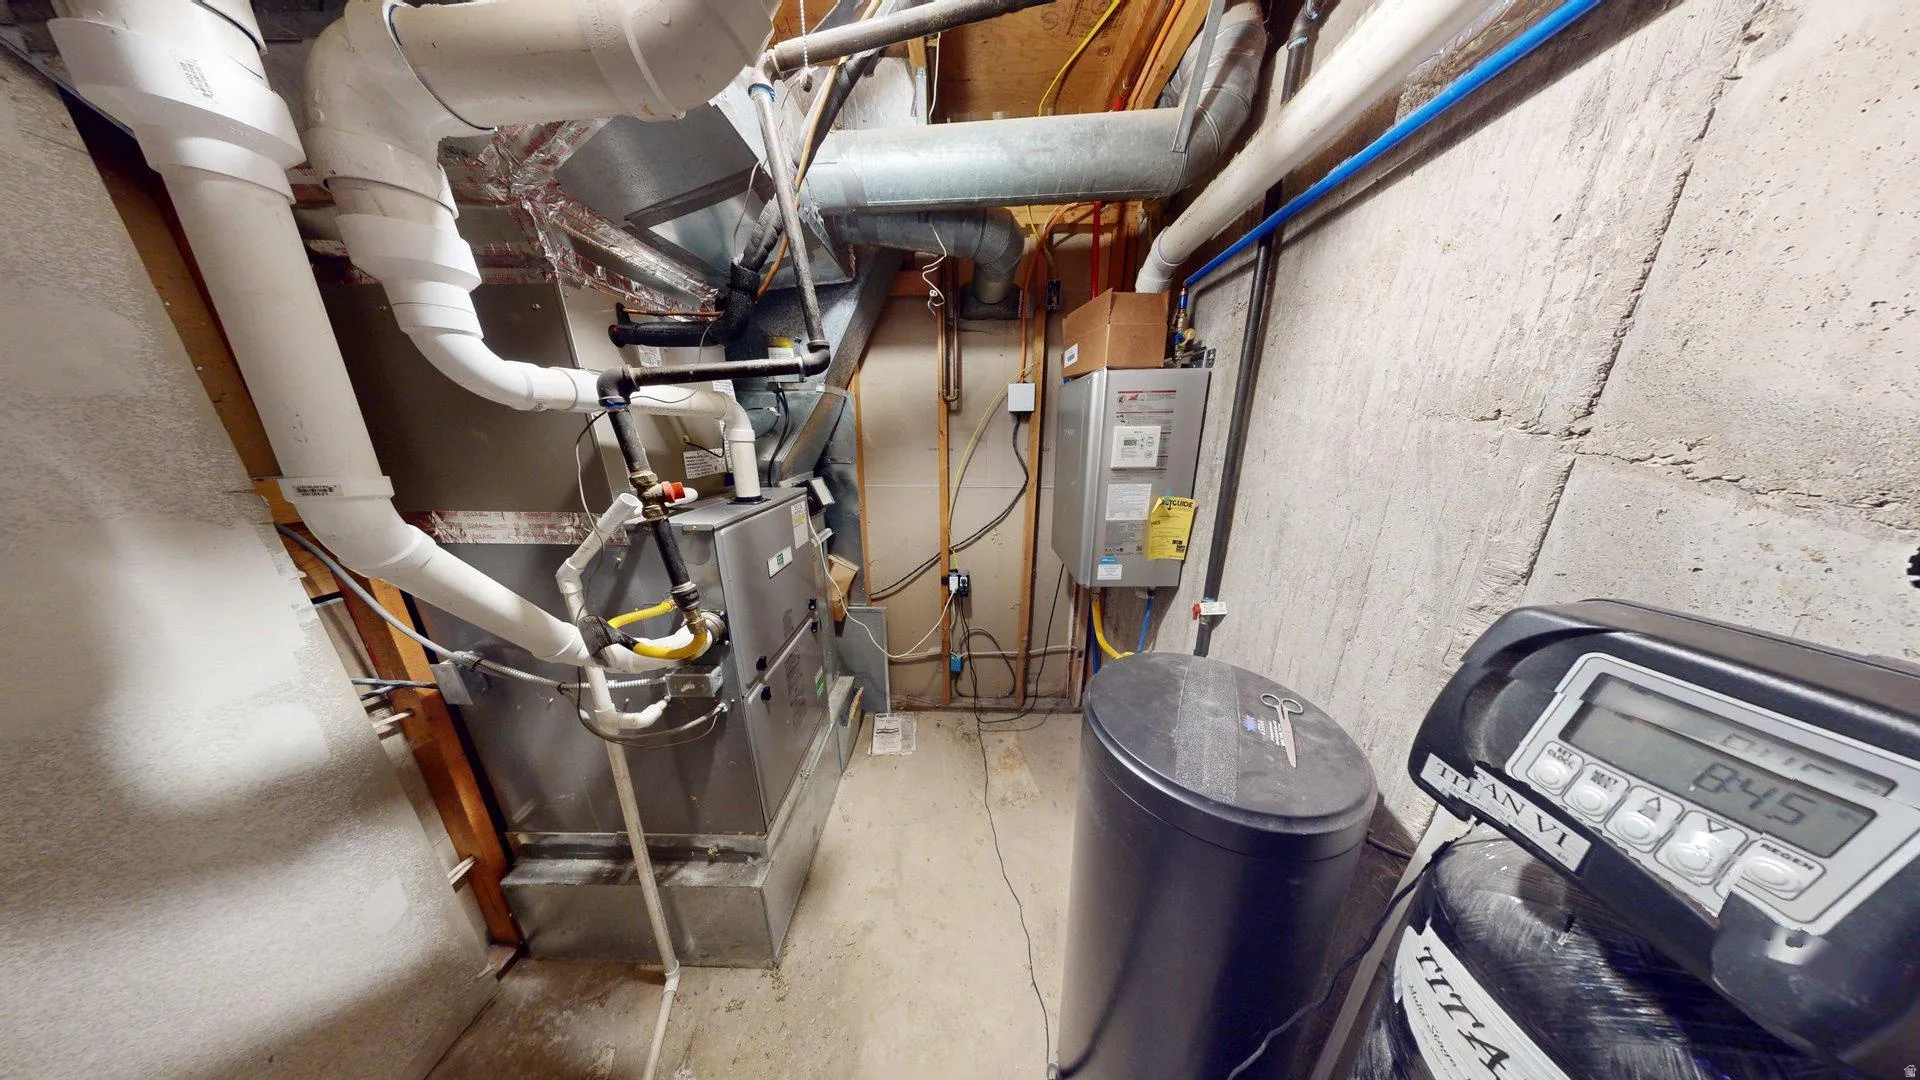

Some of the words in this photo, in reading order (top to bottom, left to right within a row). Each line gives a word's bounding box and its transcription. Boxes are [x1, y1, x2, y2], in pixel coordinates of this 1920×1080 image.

[1536, 813, 1569, 848] VI
[1760, 843, 1815, 871] REGEN
[1415, 946, 1511, 1080] TITA
